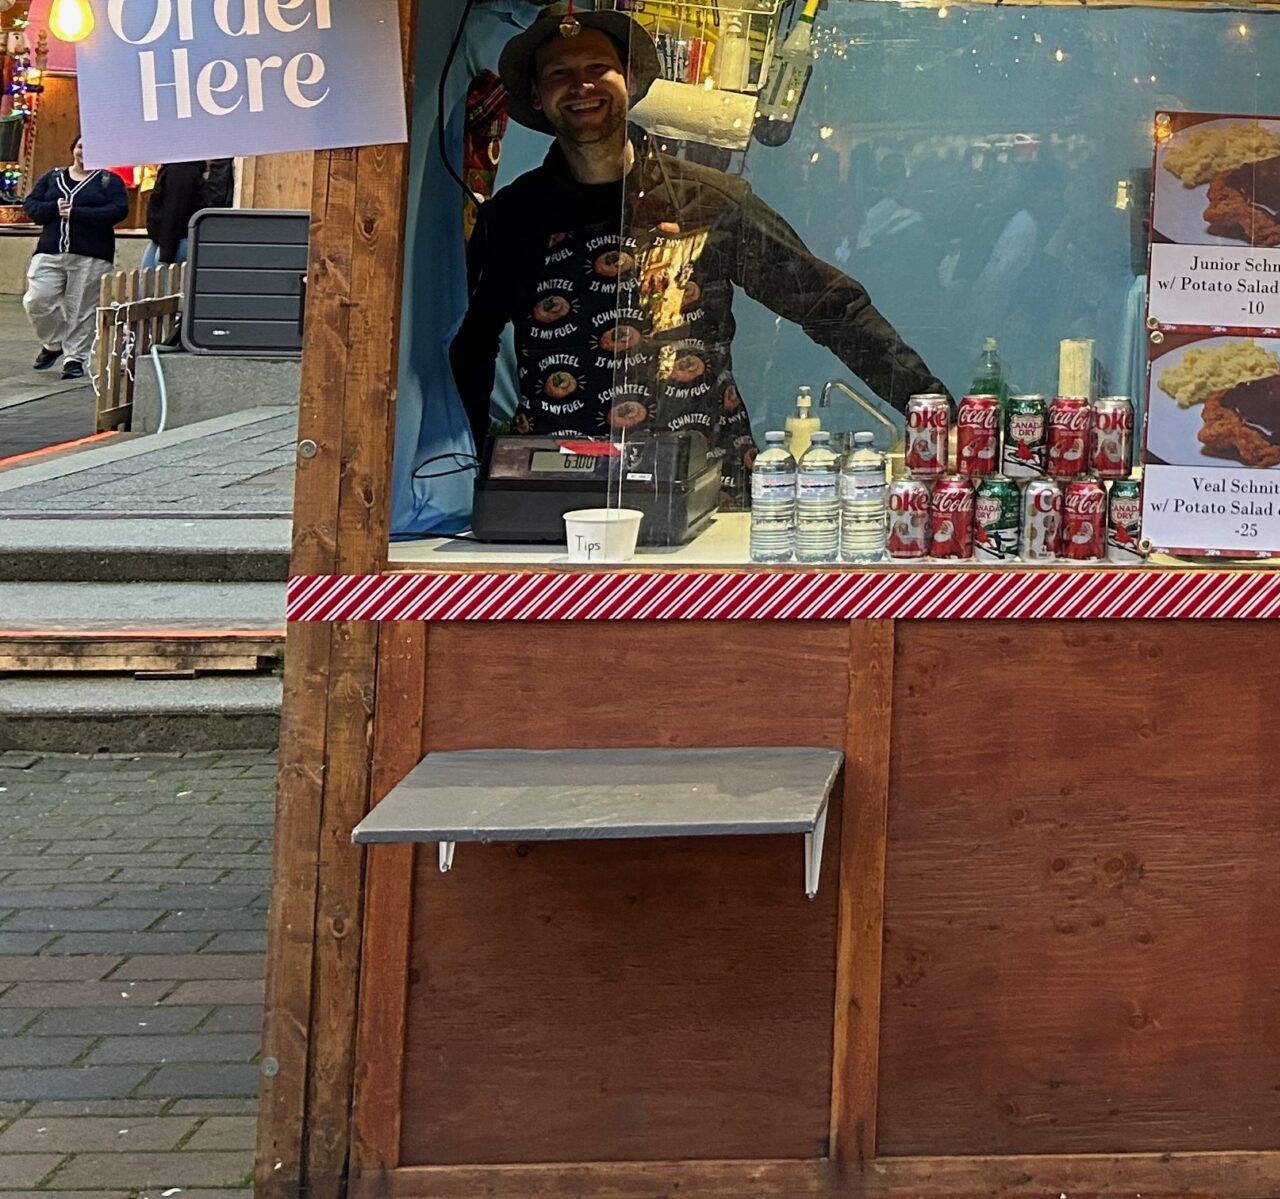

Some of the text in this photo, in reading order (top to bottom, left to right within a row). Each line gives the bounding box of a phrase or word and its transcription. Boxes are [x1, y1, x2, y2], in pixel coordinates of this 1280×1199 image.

[138, 48, 330, 122] Here
[1190, 256, 1240, 272] Junior
[589, 281, 600, 291] IS
[601, 284, 616, 293] MY
[1158, 276, 1175, 291] w/
[1180, 277, 1232, 292] Potato
[1237, 279, 1278, 294] Salad
[1241, 301, 1264, 315] -10
[592, 308, 644, 327] SCHNITZEL
[530, 323, 577, 339] IS MY FUEL
[538, 354, 579, 372] SCHNITZEL
[595, 357, 606, 367] IS
[607, 359, 622, 369] MY
[598, 383, 651, 404] SCHNITZEL
[665, 382, 710, 399] IS MY FUEL
[562, 400, 584, 414] FUEL
[668, 413, 711, 431] SCHNITZEL
[1018, 428, 1036, 437] DRY
[1192, 478, 1225, 492] Veal
[1151, 499, 1169, 513] w/
[1174, 499, 1225, 514] Potato
[1231, 501, 1272, 516] Salad
[1235, 523, 1258, 537] -25
[576, 535, 600, 560] Tips
